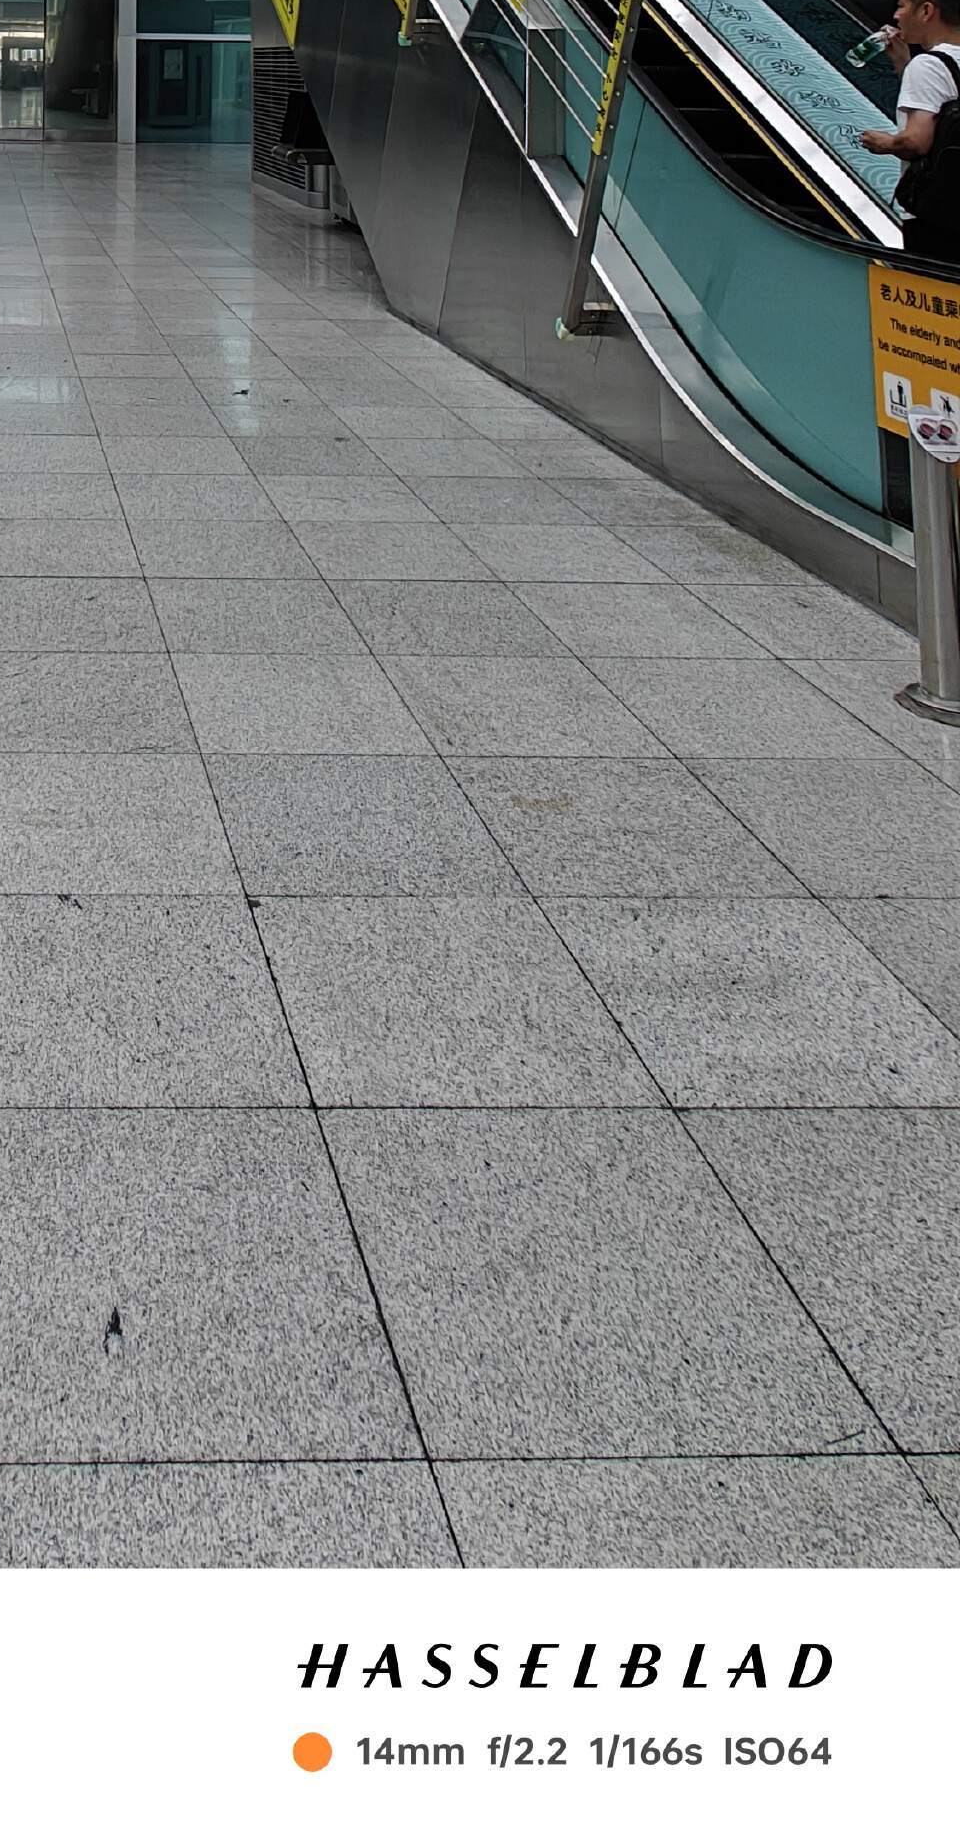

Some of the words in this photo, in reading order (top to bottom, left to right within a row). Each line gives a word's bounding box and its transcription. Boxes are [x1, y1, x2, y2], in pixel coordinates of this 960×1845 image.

[880, 283, 960, 319] 老人及儿童乘
[889, 317, 907, 334] The
